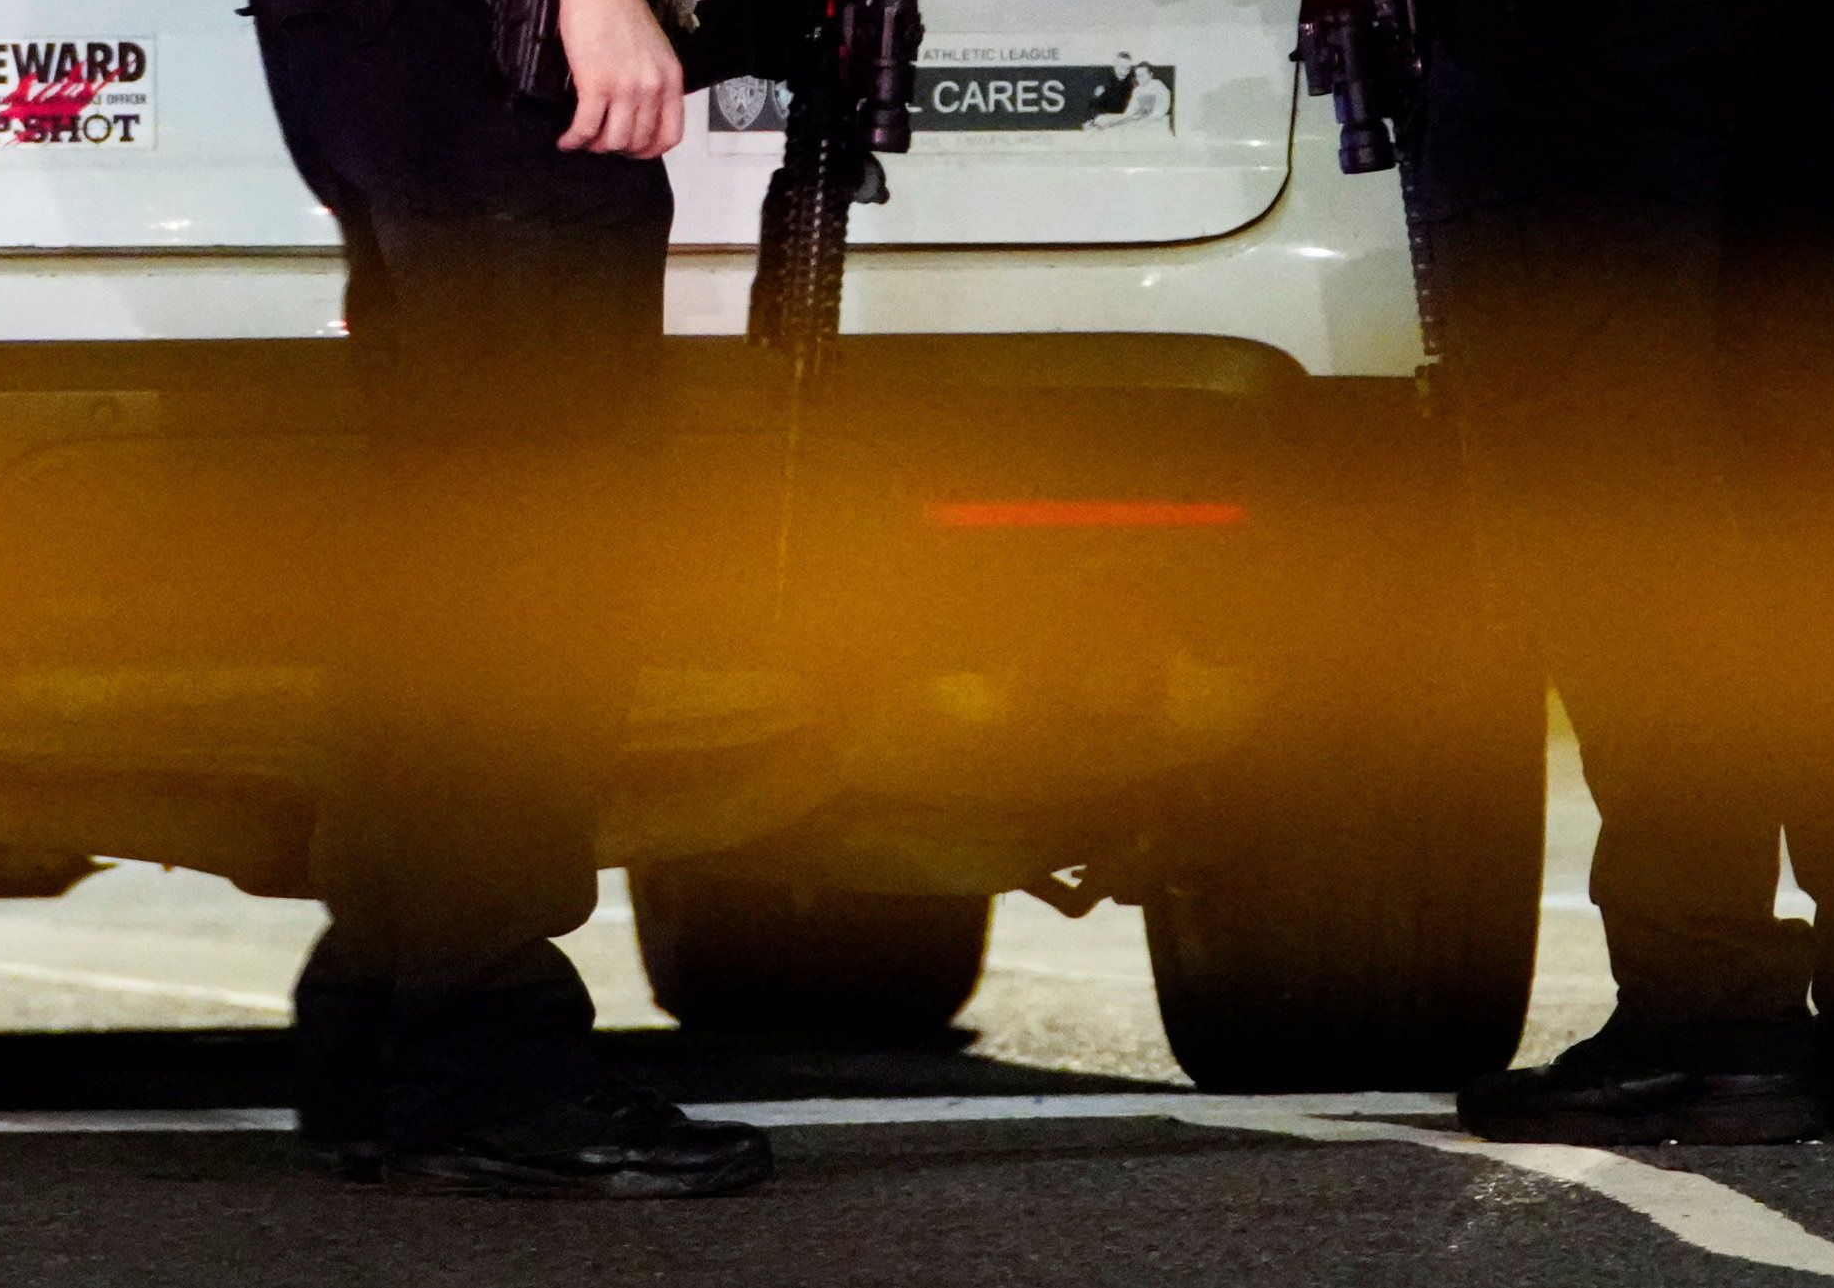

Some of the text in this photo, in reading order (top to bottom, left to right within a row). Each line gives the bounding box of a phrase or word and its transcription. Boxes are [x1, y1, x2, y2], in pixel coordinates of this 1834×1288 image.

[921, 46, 1061, 61] ATHLETIC LEAGUE
[105, 93, 148, 106] OFFICER
[932, 79, 1066, 114] CARES
[22, 113, 141, 144] SHOT
